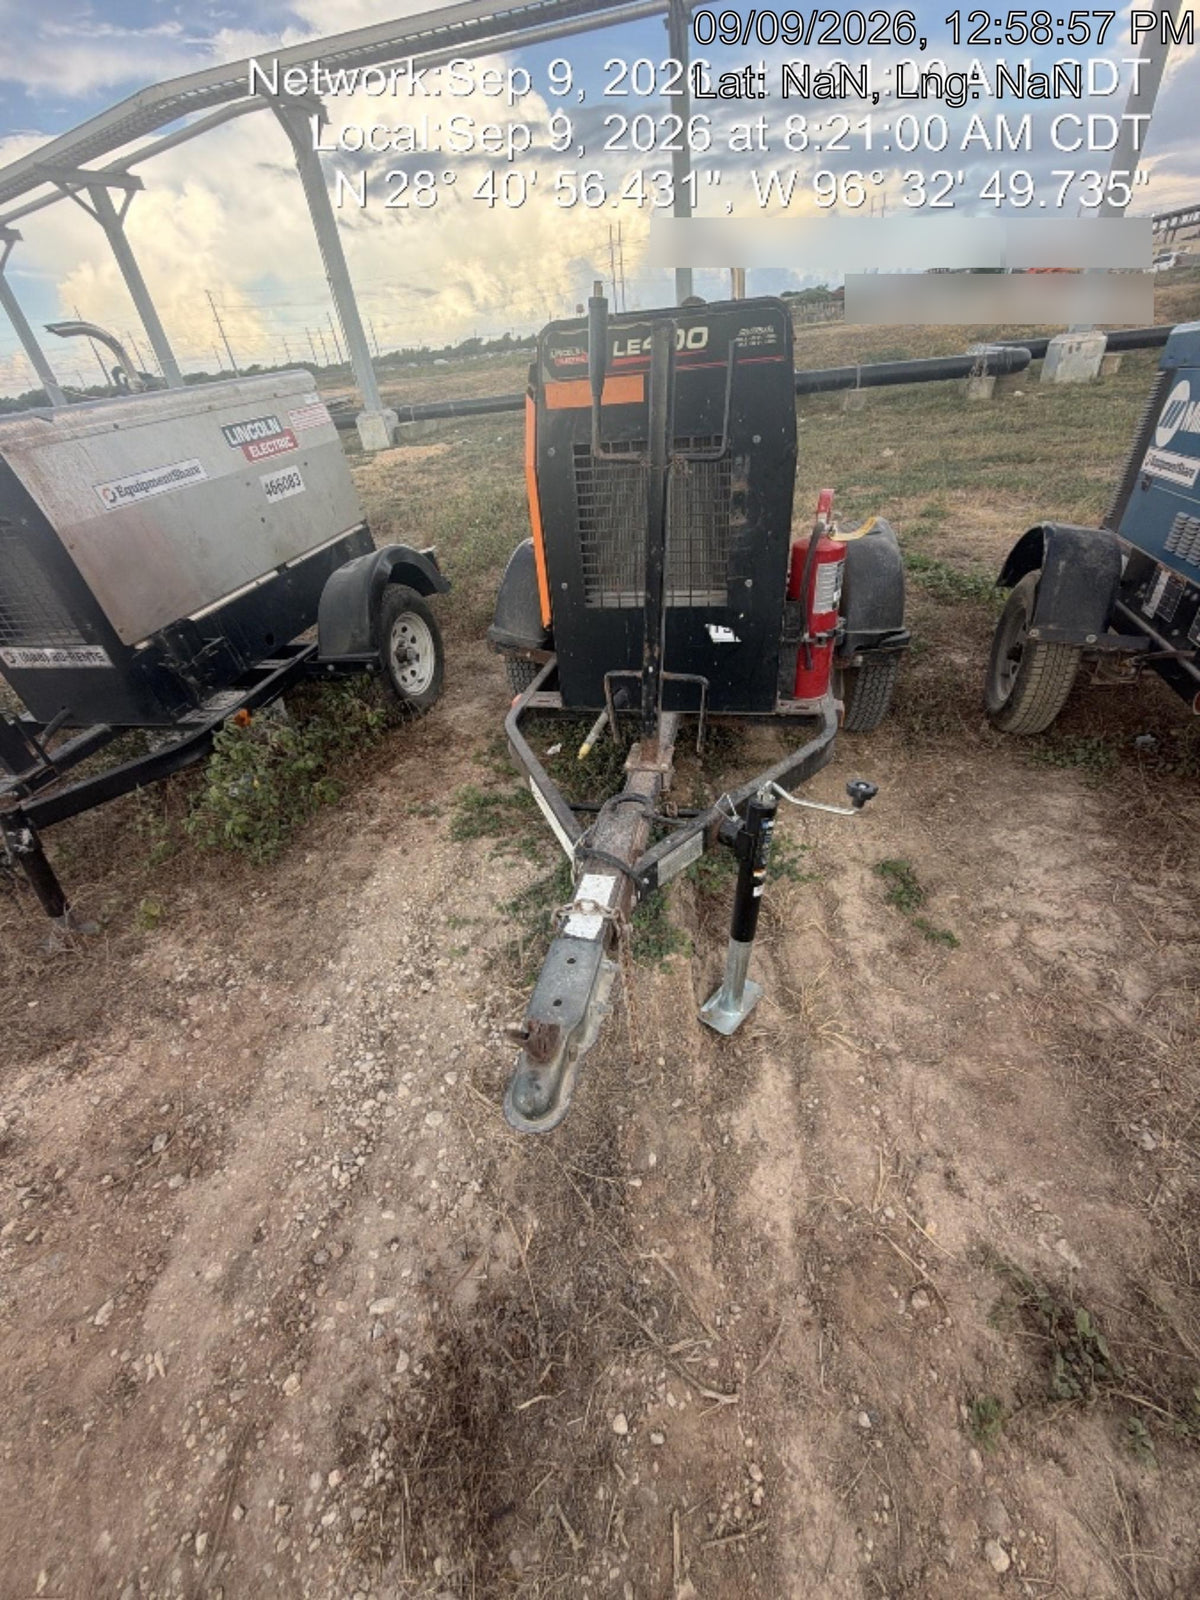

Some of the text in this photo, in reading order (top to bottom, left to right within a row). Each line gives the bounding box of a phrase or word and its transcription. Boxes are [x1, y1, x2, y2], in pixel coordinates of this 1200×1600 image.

[224, 416, 283, 446] LINCOLN
[247, 436, 296, 459] ELECTRIC
[114, 464, 202, 499] EquipmentShare
